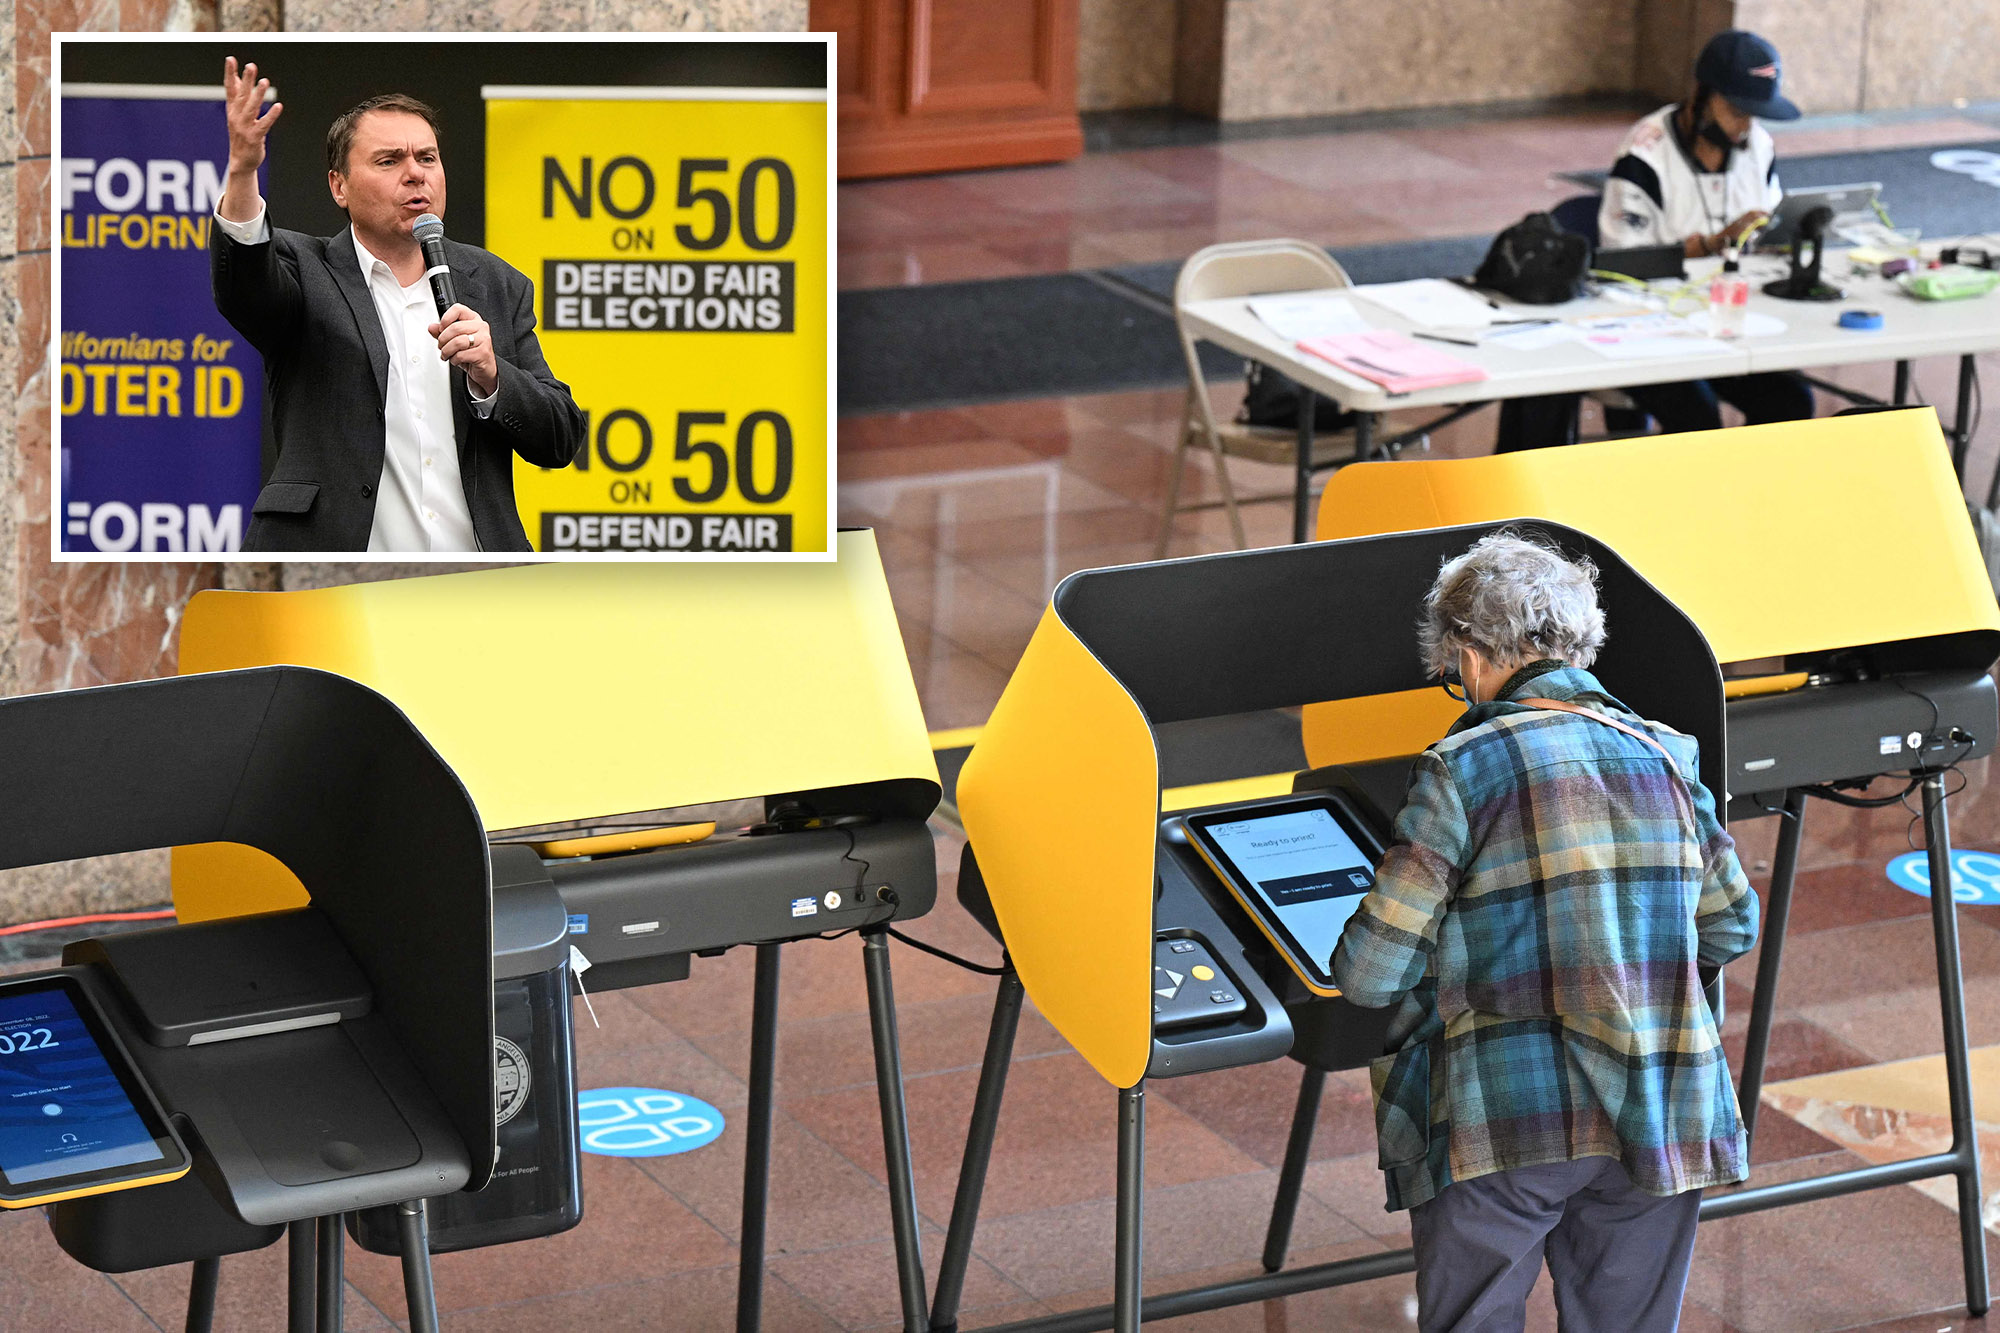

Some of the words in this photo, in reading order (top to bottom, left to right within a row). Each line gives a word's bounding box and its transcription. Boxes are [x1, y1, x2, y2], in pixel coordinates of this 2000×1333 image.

[61, 158, 230, 212] FORM
[541, 155, 656, 220] NO
[674, 157, 796, 252] 50
[61, 214, 212, 249] LIFORN
[612, 227, 654, 250] ON
[554, 263, 696, 296] DEFEND
[704, 264, 782, 297] FAIR
[554, 297, 783, 330] ELECTIONS
[191, 333, 233, 361] for
[61, 362, 182, 417] OTER
[194, 365, 244, 418] ID
[672, 410, 794, 505] 50
[609, 480, 652, 504] ON
[553, 516, 694, 548] DEFEND
[702, 516, 779, 548] FAIR
[1251, 840, 1279, 848] Ready
[1291, 833, 1315, 844] print?
[5, 1023, 31, 1031] ELECTION
[497, 1041, 522, 1063] ANGELES
[518, 1165, 539, 1175] People
